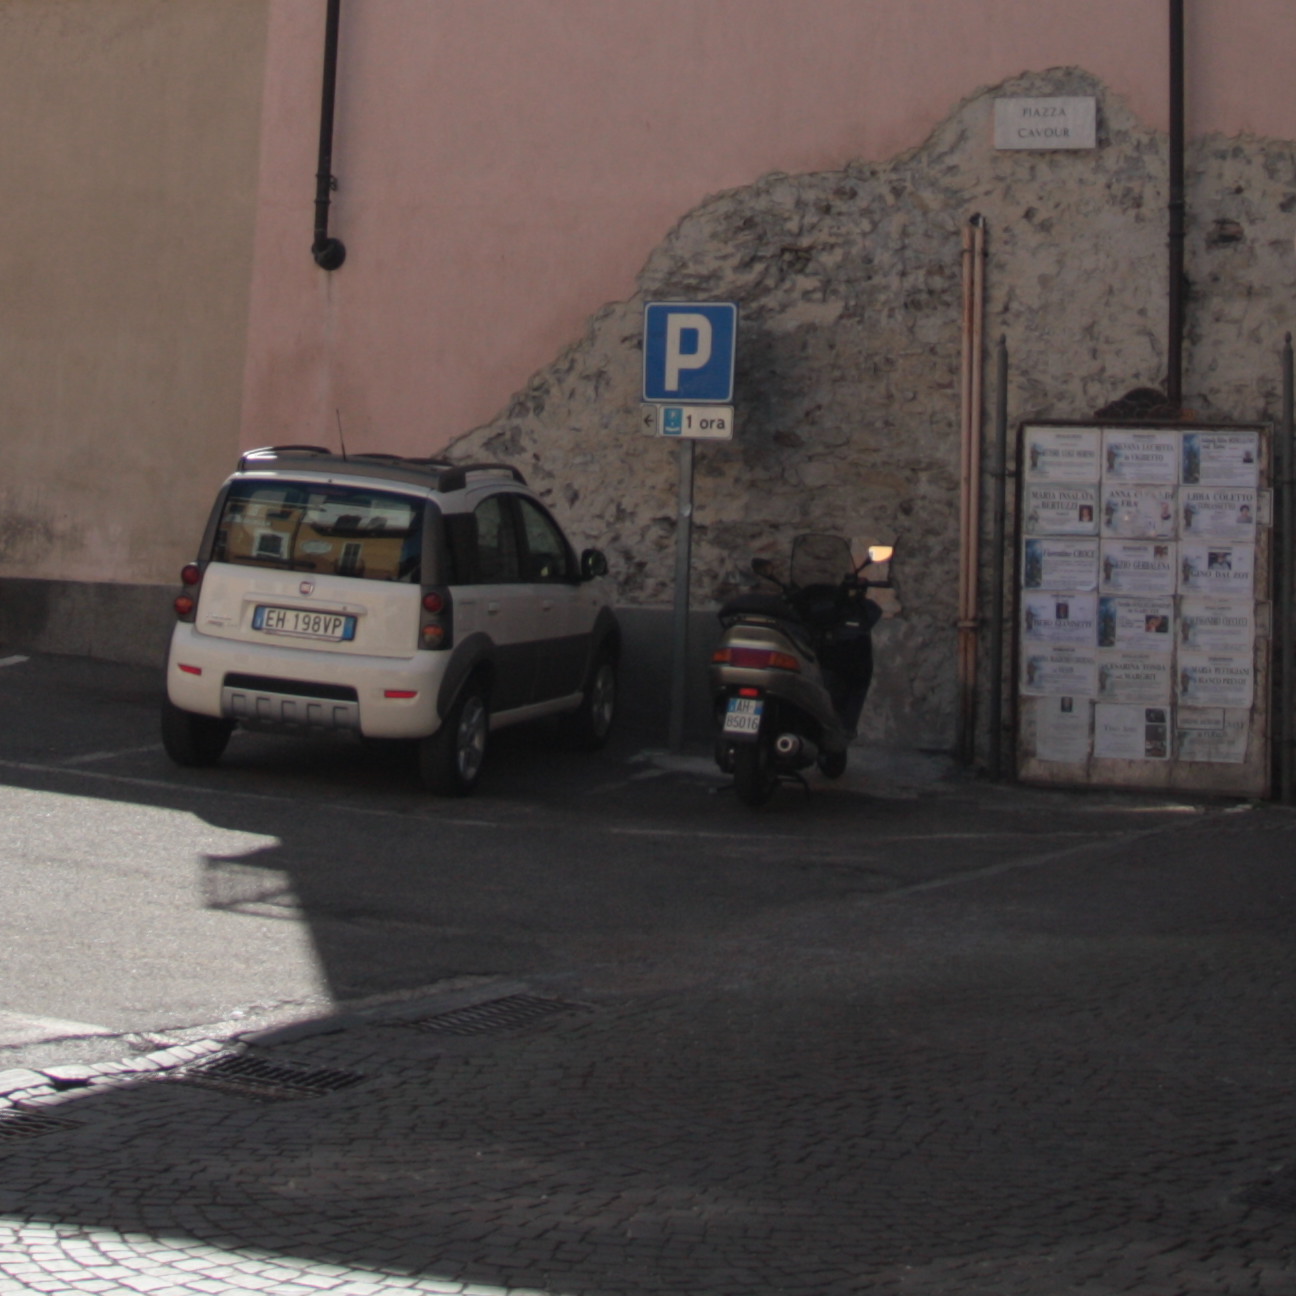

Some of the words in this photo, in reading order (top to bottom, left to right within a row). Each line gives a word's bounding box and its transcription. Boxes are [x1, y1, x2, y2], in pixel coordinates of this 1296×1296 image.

[1022, 106, 1067, 117] PIAZZA
[1017, 127, 1070, 138] CAVOUR
[665, 313, 712, 391] P
[686, 413, 692, 429] 1
[699, 417, 726, 430] ora
[265, 608, 286, 629] EH
[294, 612, 342, 635] 198VP
